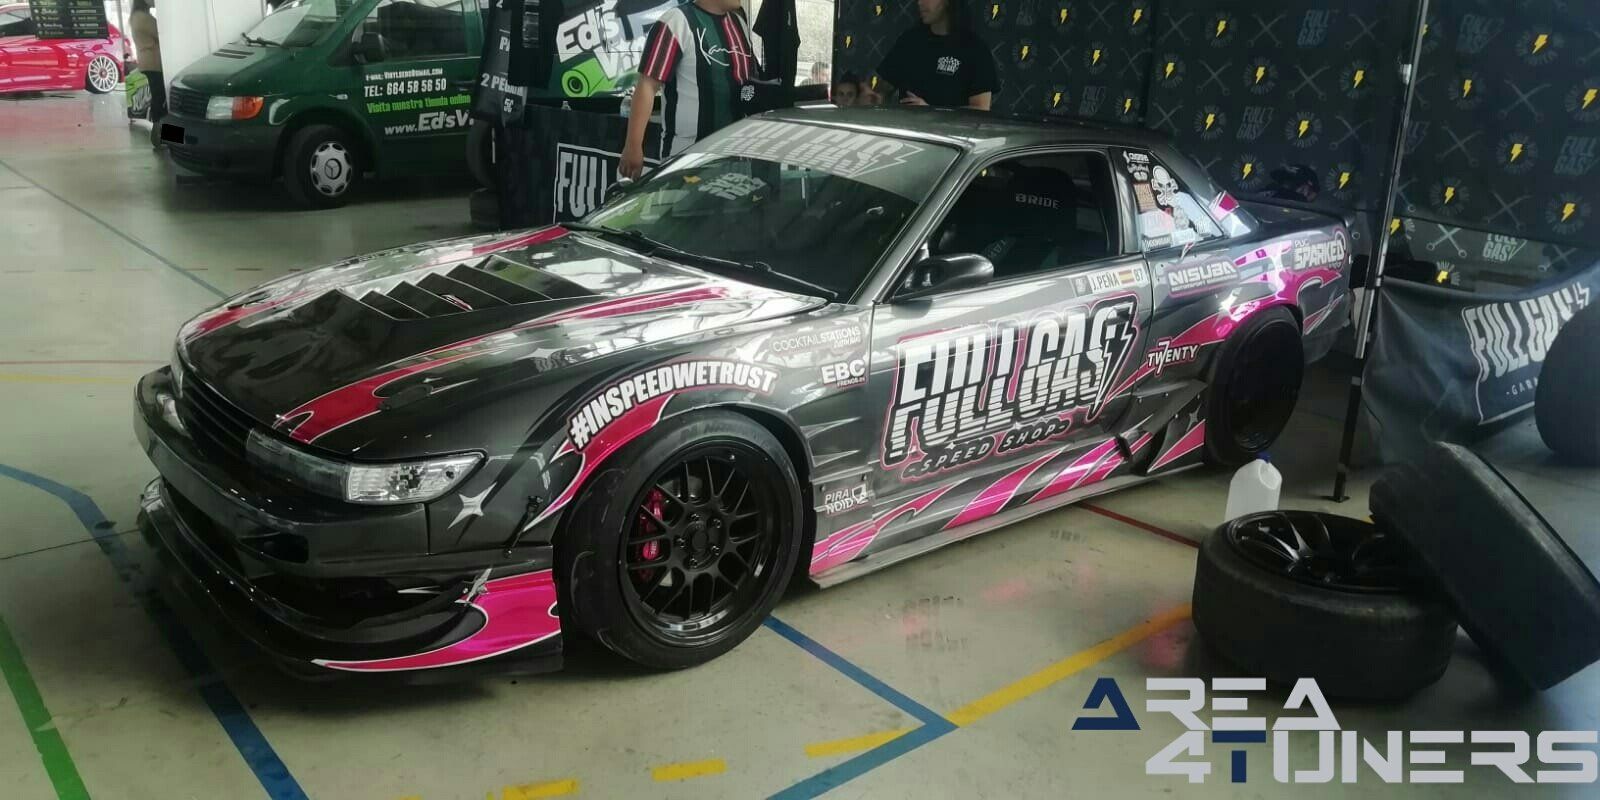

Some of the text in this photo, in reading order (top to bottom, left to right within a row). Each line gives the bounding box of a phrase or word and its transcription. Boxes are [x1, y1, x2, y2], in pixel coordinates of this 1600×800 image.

[364, 78, 447, 97] TEL: 664 58 56 50
[367, 93, 471, 113] Visita nuestra tienda online
[1016, 193, 1061, 209] BRIDE
[1293, 240, 1345, 270] SPARKED
[1482, 241, 1512, 262] GAS
[821, 360, 866, 384] EBC
[571, 361, 778, 448] #INSPEEDWETRUST
